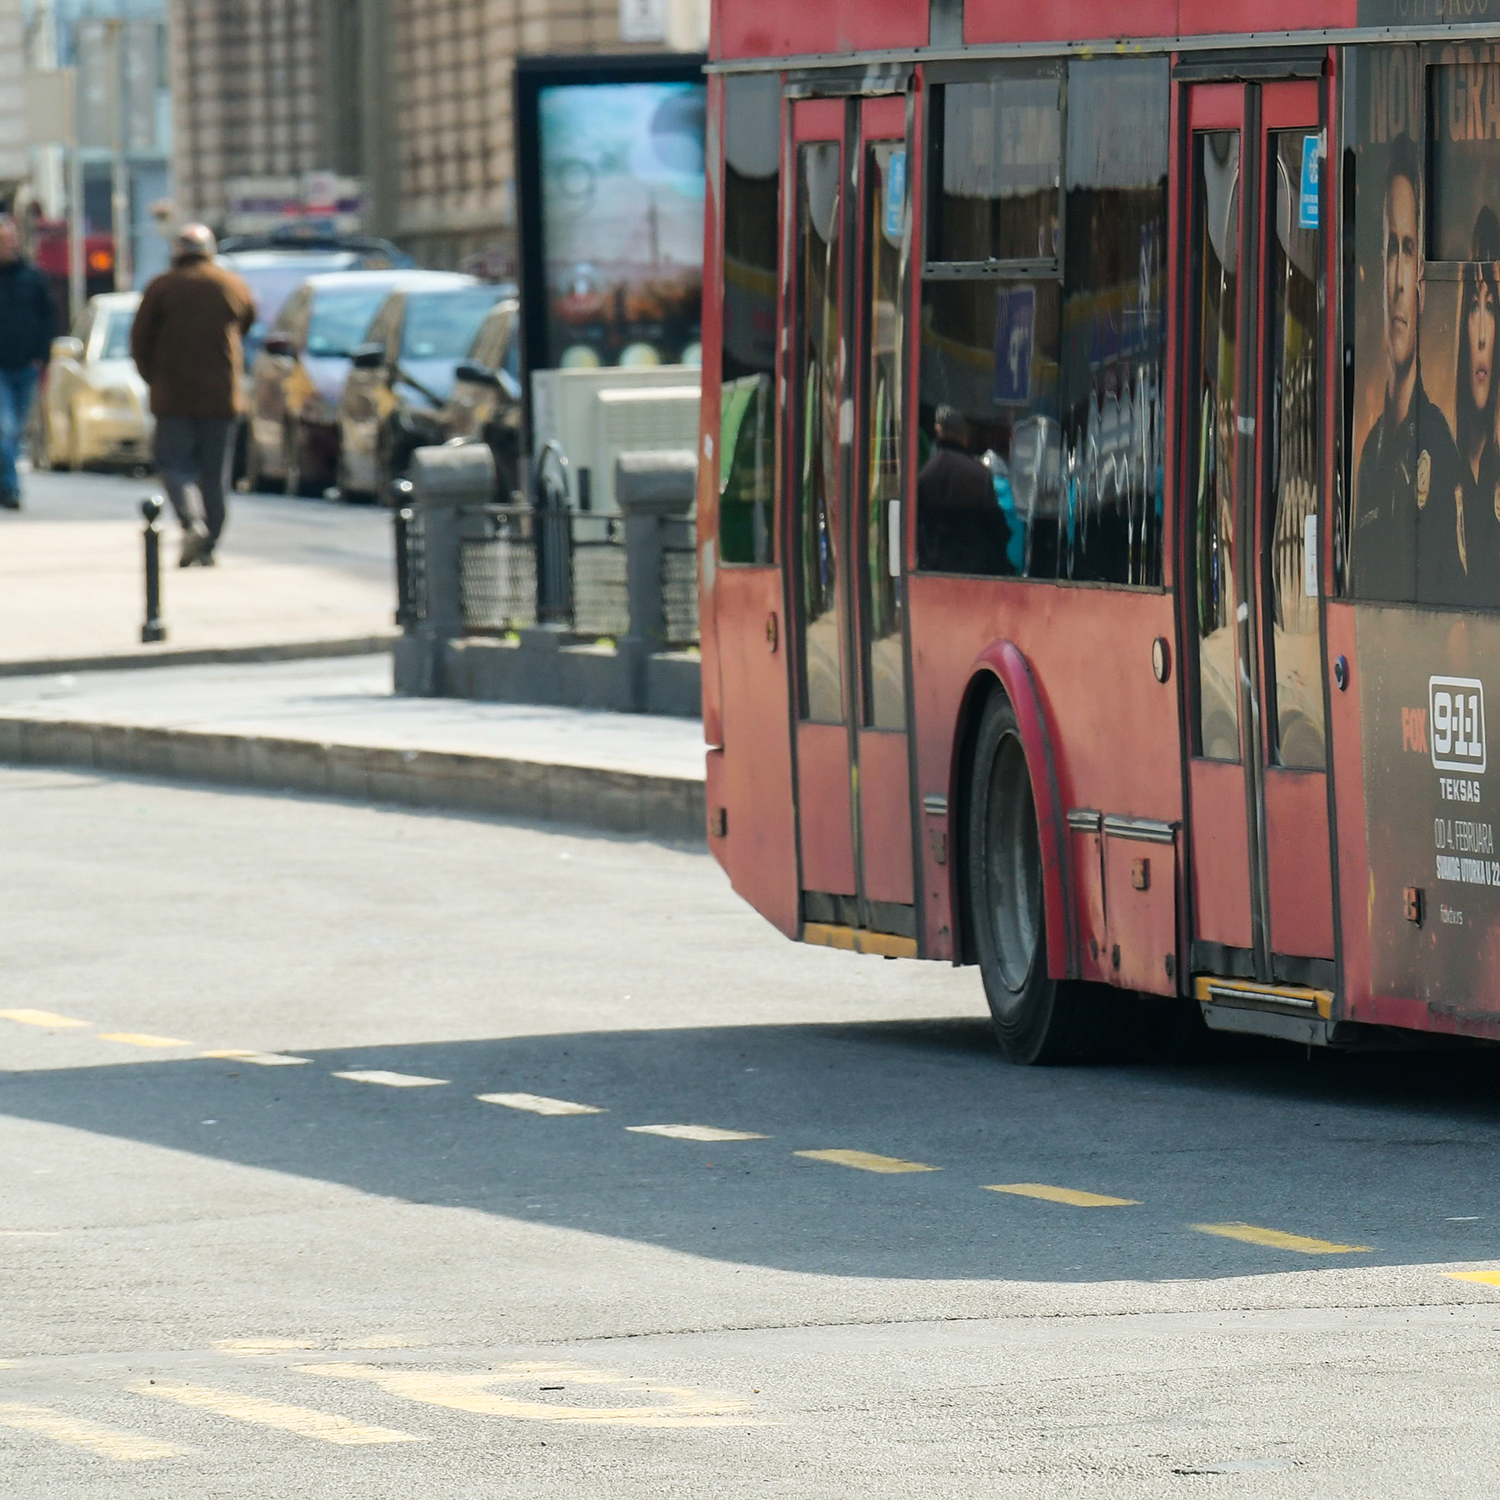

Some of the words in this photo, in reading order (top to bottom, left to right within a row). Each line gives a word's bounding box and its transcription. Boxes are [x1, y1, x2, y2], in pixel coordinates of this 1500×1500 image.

[1401, 706, 1429, 754] FOX
[1439, 777, 1481, 803] TEKSAS
[1434, 818, 1446, 849] OD
[1455, 820, 1494, 854] FEBRUARA
[1460, 858, 1486, 885] UTORKA
